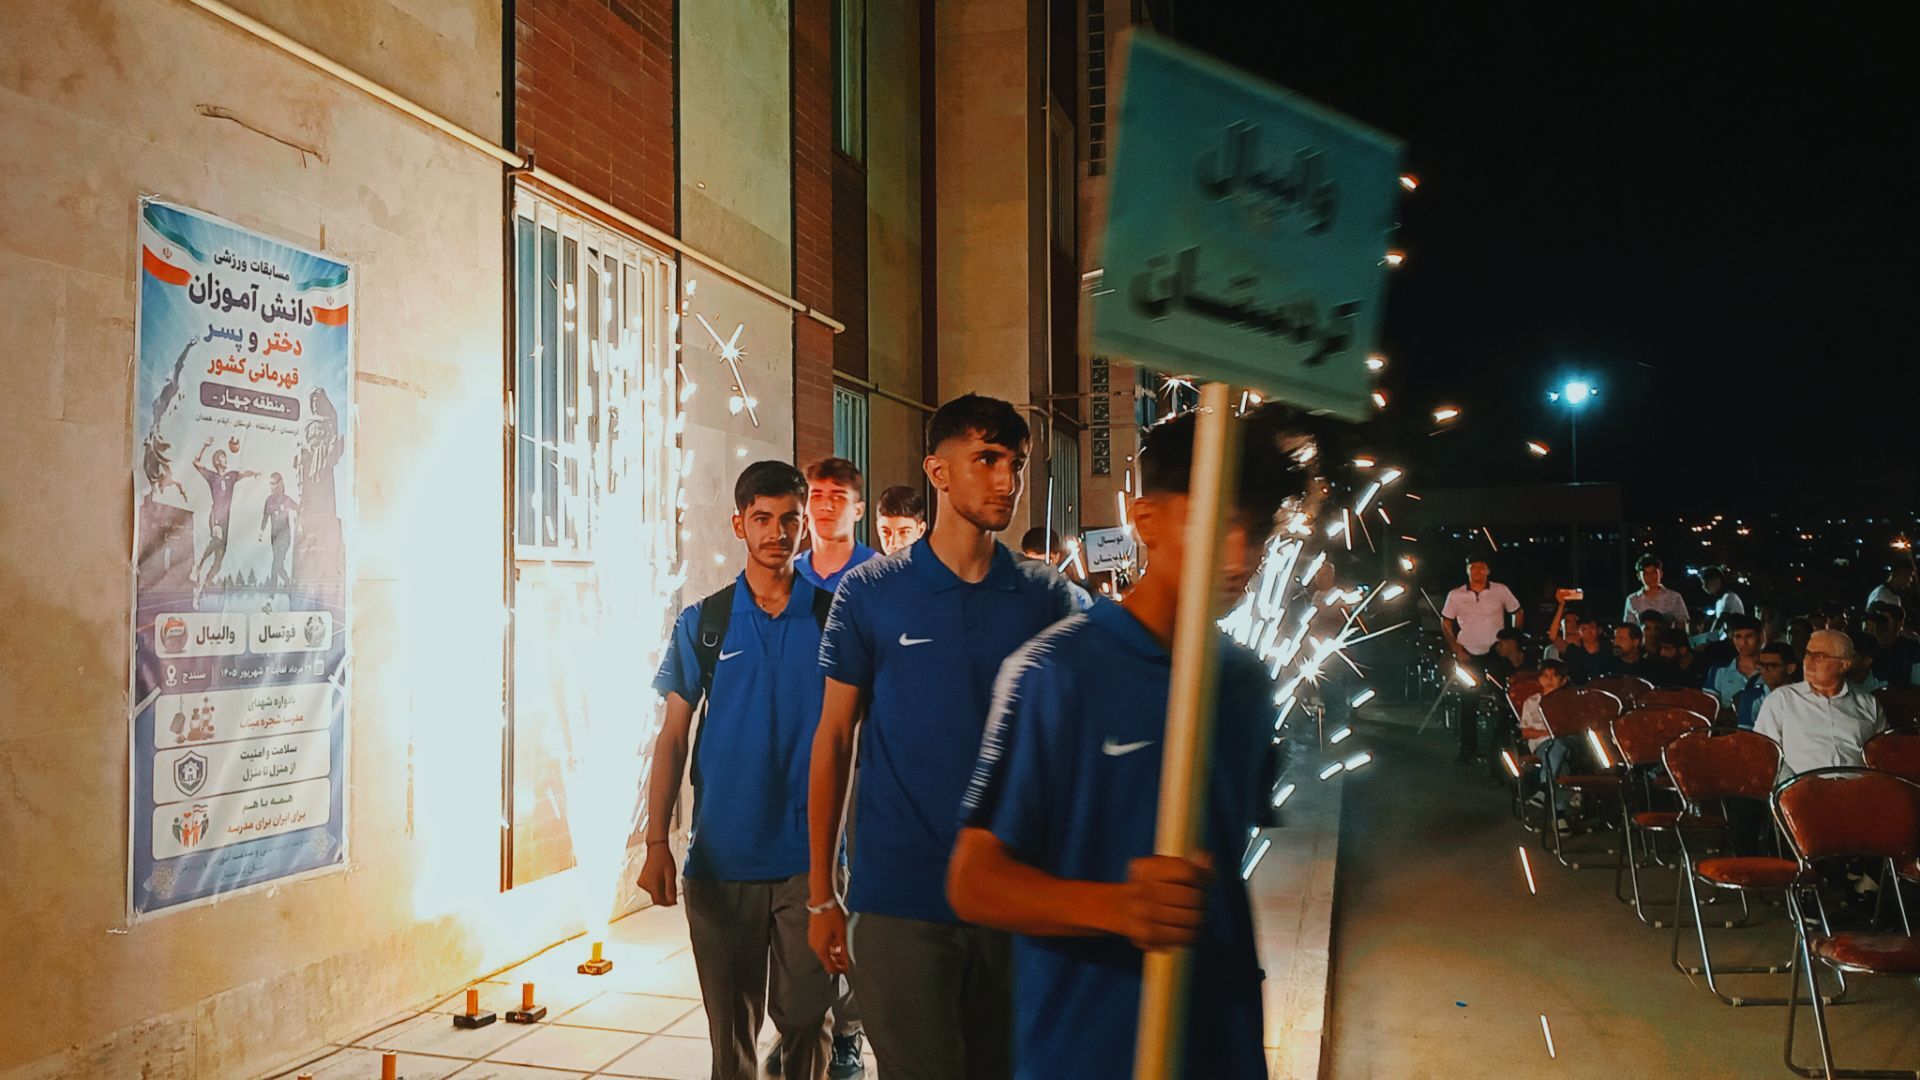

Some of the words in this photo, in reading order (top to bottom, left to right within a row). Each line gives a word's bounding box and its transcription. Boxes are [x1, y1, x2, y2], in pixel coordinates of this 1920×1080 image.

[213, 250, 248, 272] ورزشی
[250, 261, 290, 282] مسابقات
[188, 272, 259, 313] آموزان
[260, 293, 314, 326] دانش
[203, 323, 244, 351] پسر
[248, 331, 258, 352] و
[262, 332, 303, 356] دختر
[206, 354, 247, 376] کشور
[248, 363, 299, 390] قهرمانی
[219, 388, 252, 412] چهار
[252, 393, 286, 414] منطقه
[196, 625, 236, 646] والیبال
[258, 625, 296, 644] فوتسال
[182, 671, 206, 684] سنندج
[240, 667, 264, 679] شهریور
[248, 696, 272, 712] شهدای
[240, 747, 265, 762] امنیت
[265, 750, 270, 760] و
[271, 743, 297, 755] سلامت
[243, 768, 261, 782] منزل
[263, 766, 268, 776] تا
[270, 764, 288, 777] منزل
[290, 761, 296, 775] از
[242, 800, 259, 814] هم
[260, 797, 268, 809] با
[270, 794, 293, 805] همه
[255, 817, 271, 831] برای
[273, 812, 290, 827] ایران
[290, 810, 306, 824] برای
[227, 821, 254, 835] مدرسه
